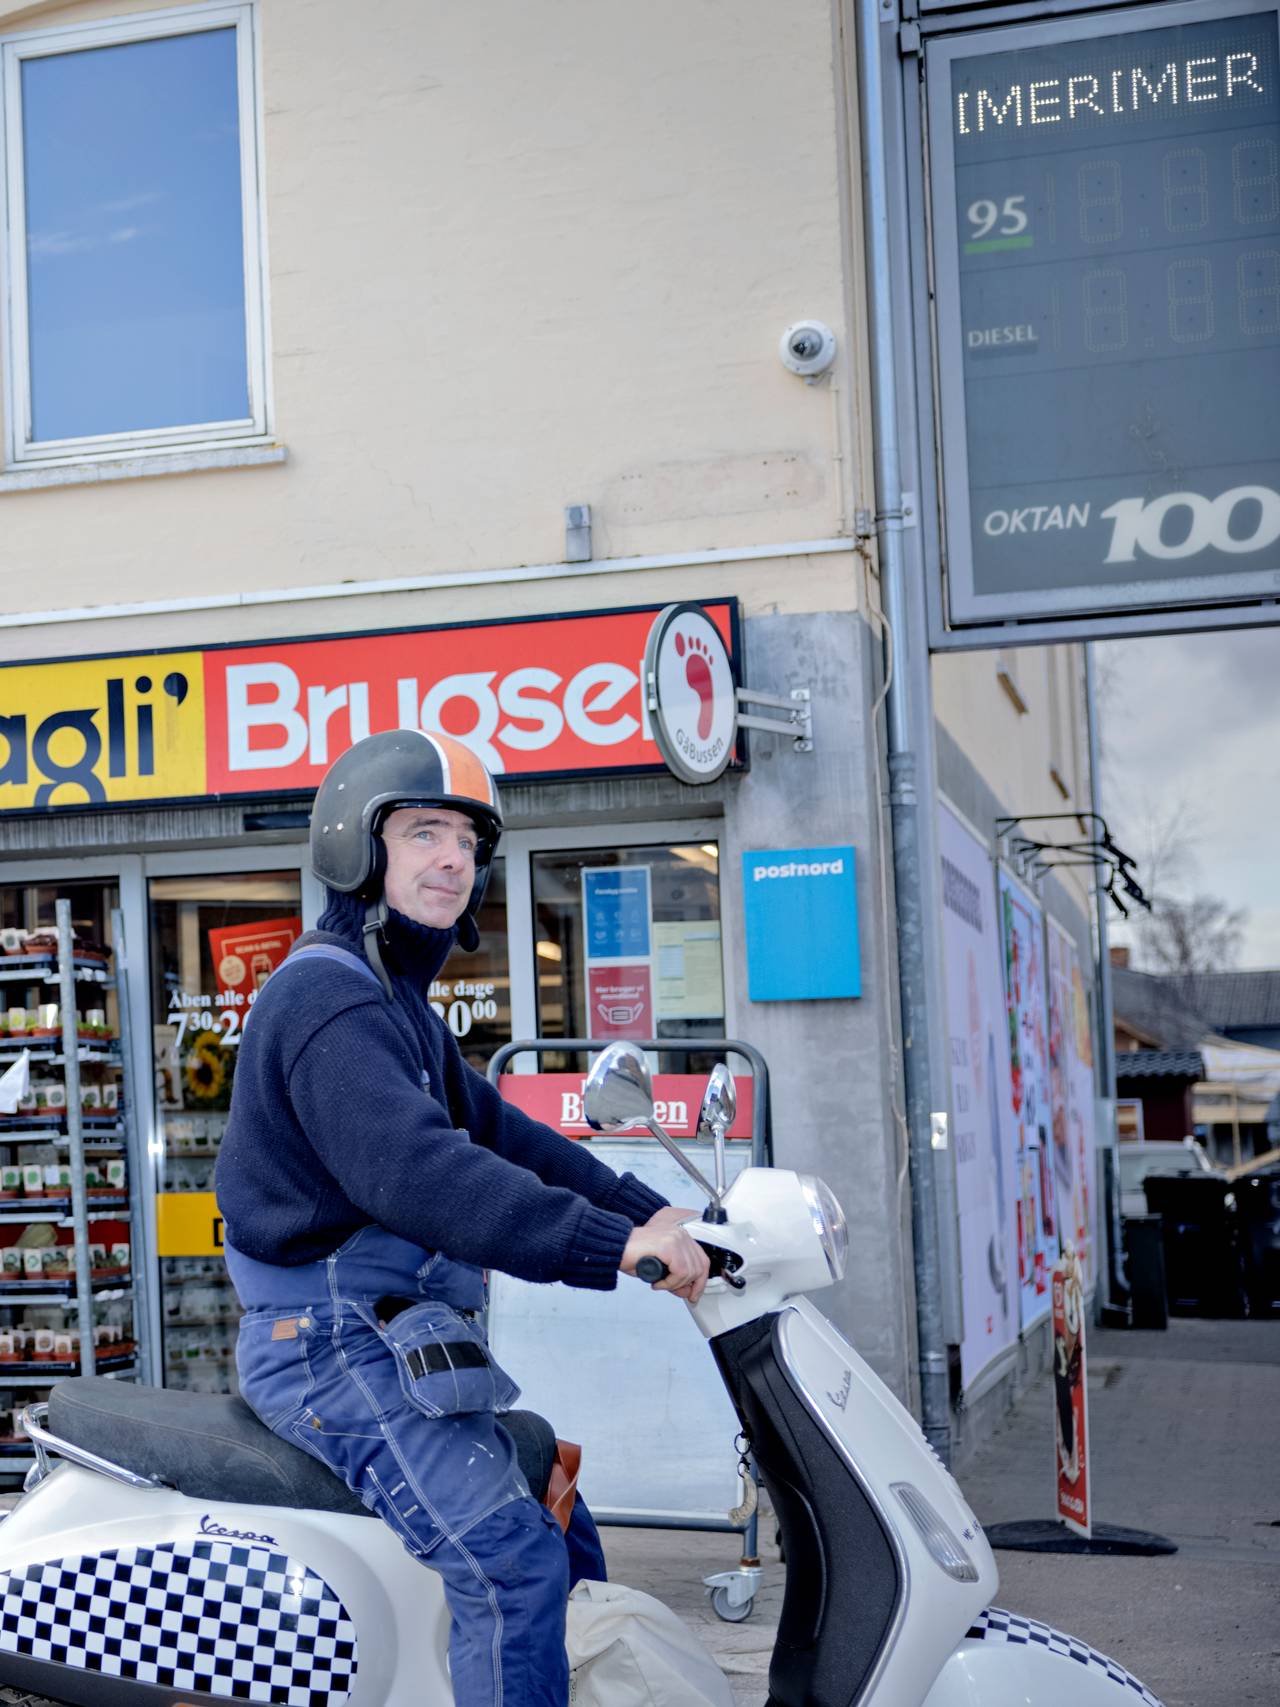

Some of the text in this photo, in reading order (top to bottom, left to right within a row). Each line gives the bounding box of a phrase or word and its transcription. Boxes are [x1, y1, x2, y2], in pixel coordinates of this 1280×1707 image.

[967, 195, 1029, 239] 95
[968, 323, 1039, 349] DIESEL
[983, 485, 1280, 565] OKTAN 100
[753, 859, 844, 882] postnord
[168, 988, 212, 1009] Åben
[214, 989, 245, 1006] alle
[428, 980, 495, 1000] lle dage
[196, 1514, 279, 1546] Vespa
